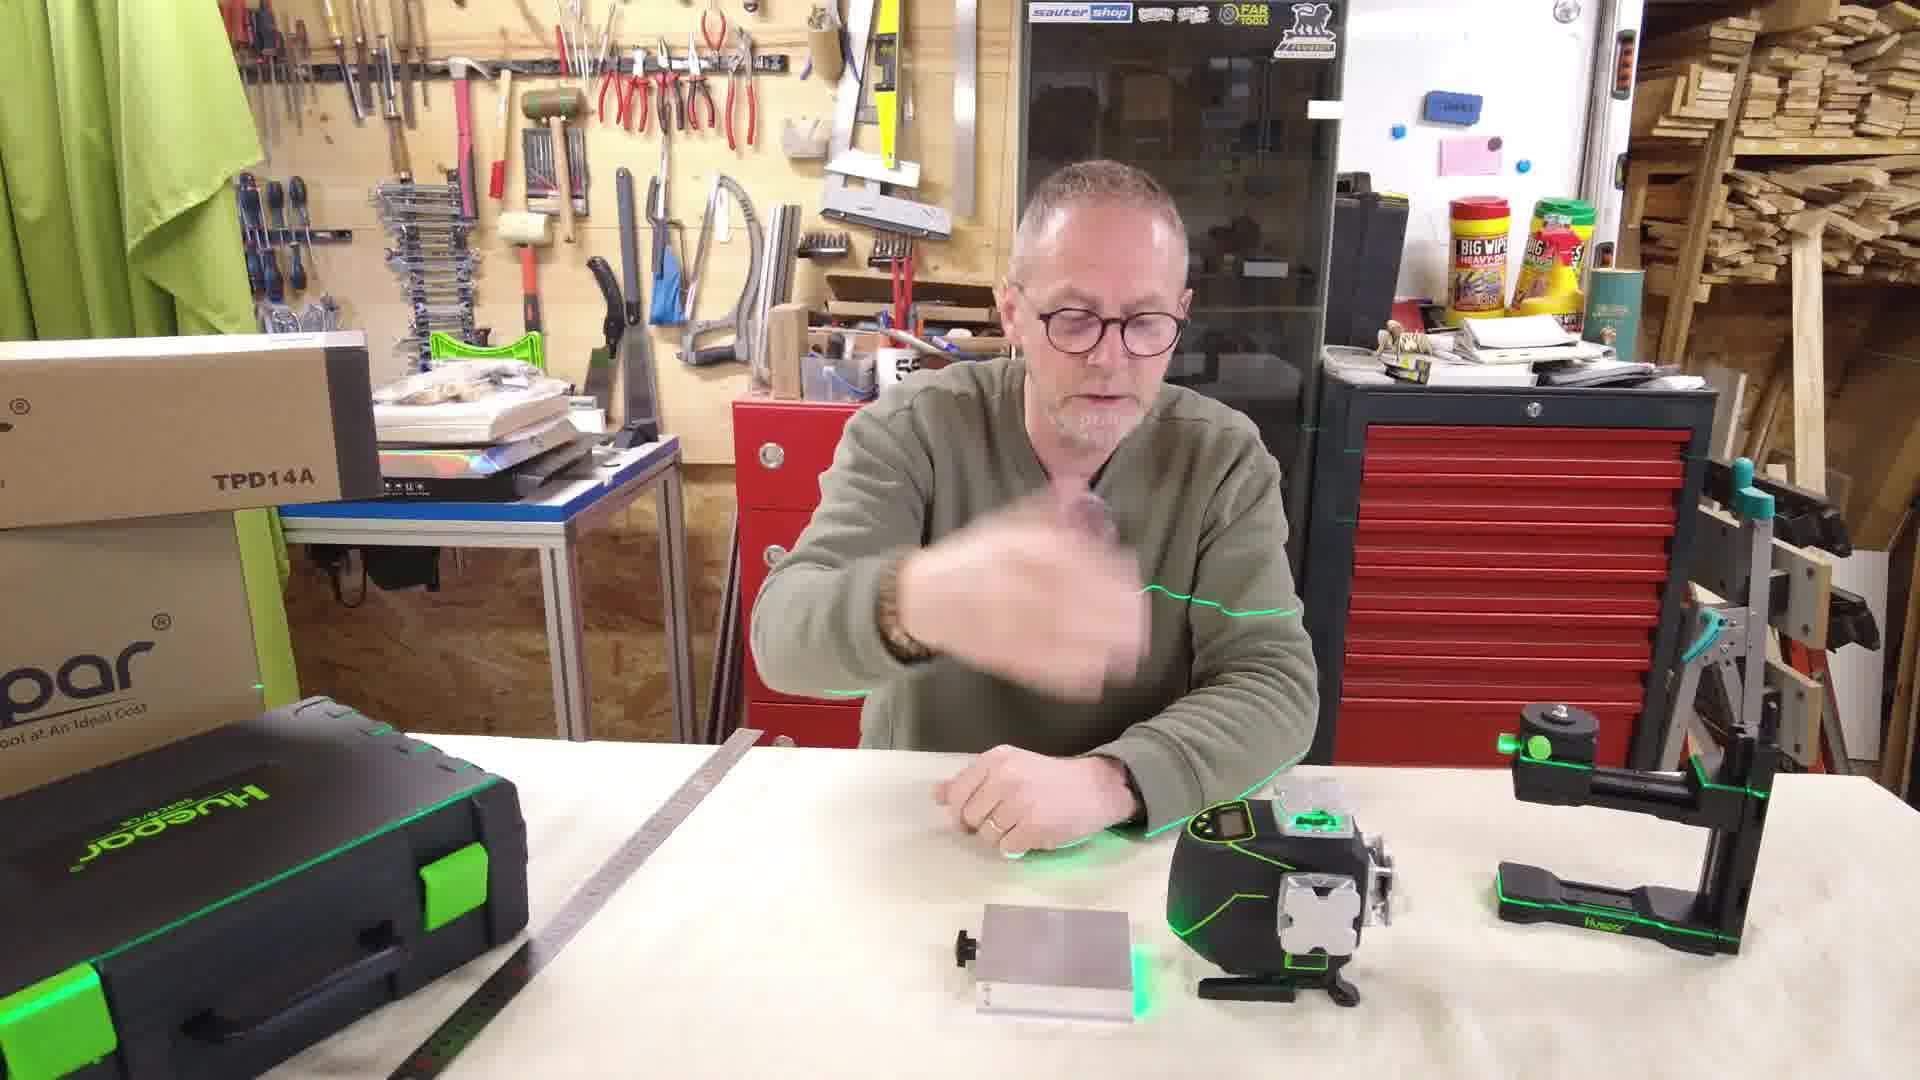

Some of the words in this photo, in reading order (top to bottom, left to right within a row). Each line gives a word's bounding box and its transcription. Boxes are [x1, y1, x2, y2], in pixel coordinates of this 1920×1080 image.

[1092, 7, 1128, 19] shop
[1239, 4, 1268, 16] FAR
[1461, 240, 1482, 256] BIG
[212, 467, 316, 492] TPD14A
